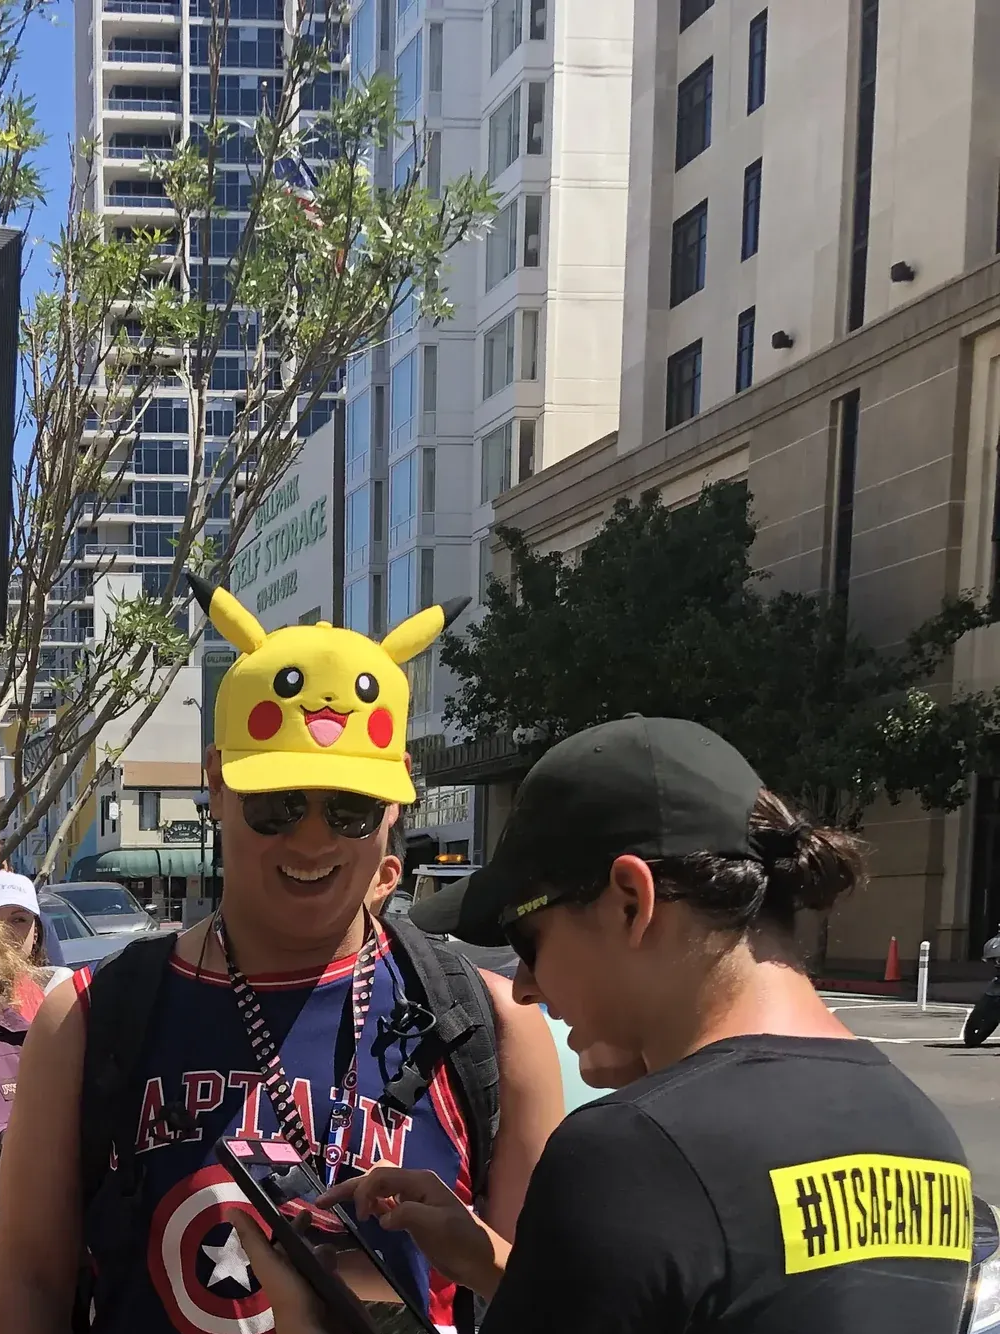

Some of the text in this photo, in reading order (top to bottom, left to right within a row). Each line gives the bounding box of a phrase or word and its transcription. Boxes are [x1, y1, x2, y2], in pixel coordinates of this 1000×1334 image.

[255, 474, 301, 533] BALLPARK
[233, 494, 328, 594] SELF STORAGE
